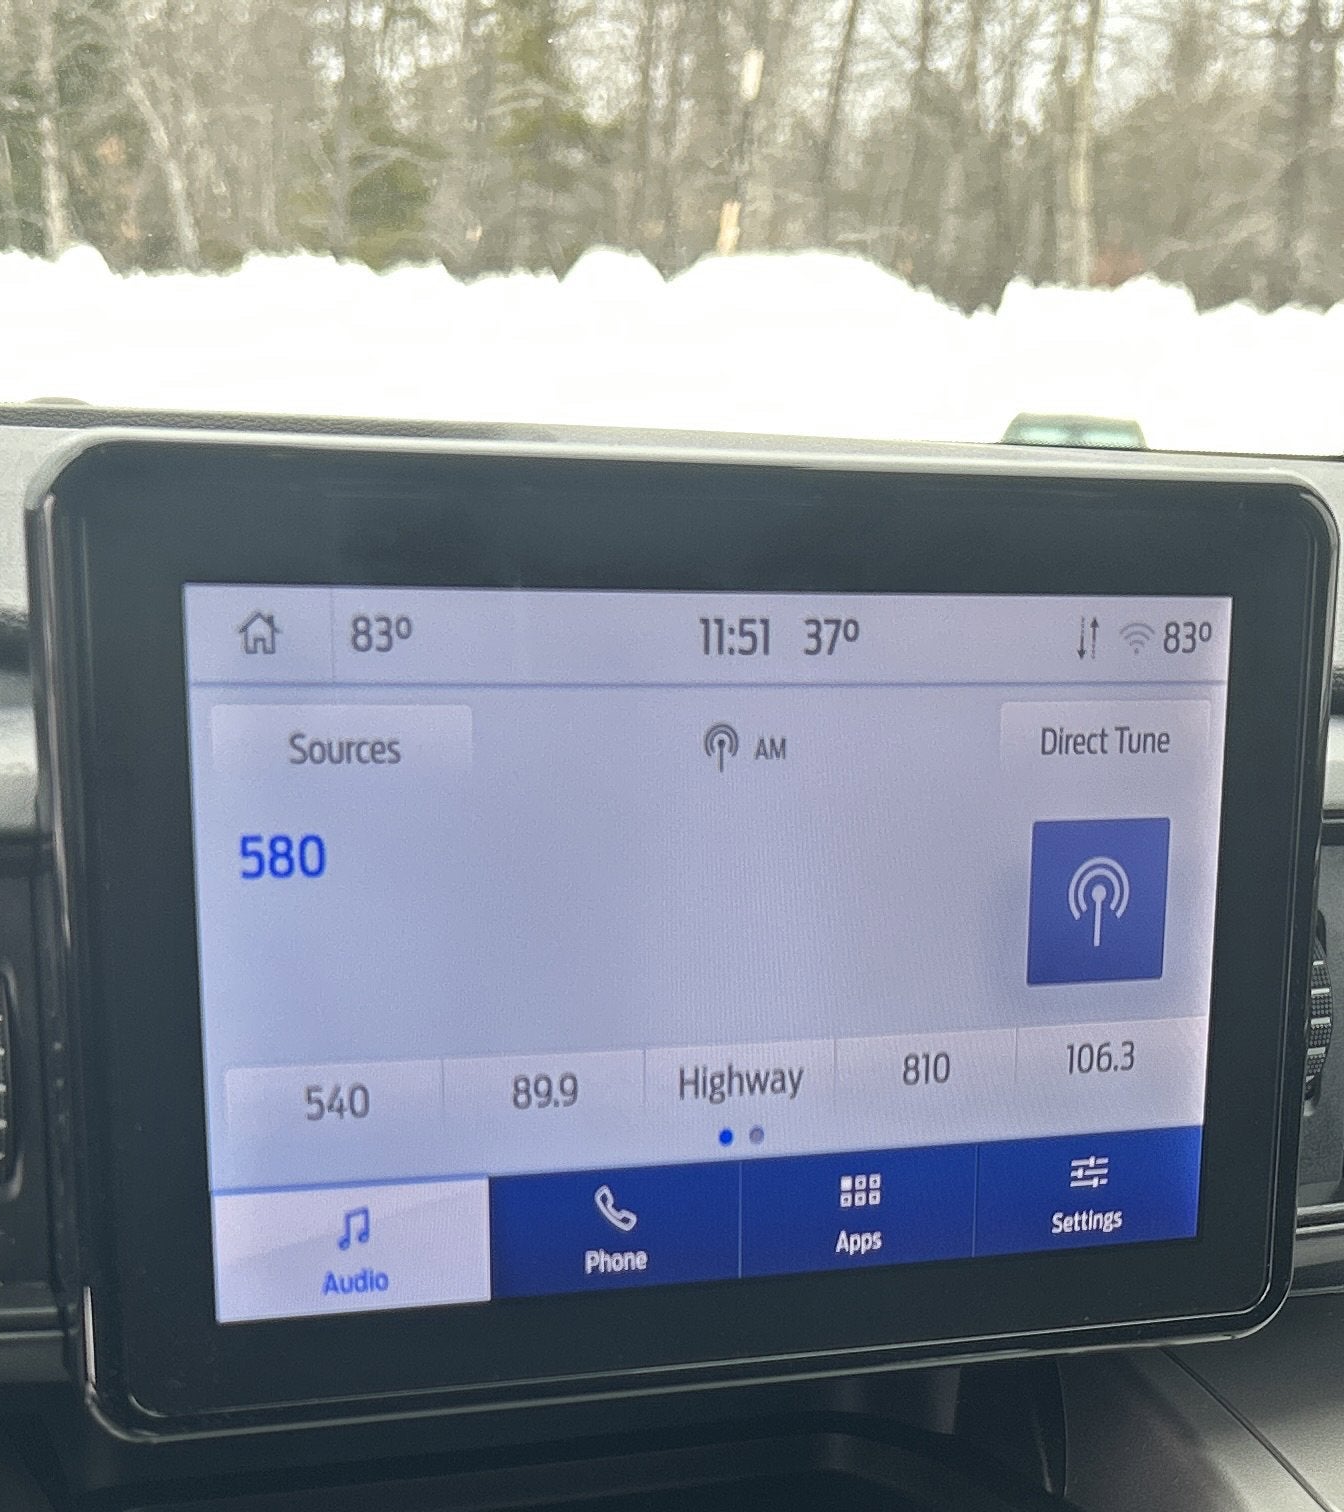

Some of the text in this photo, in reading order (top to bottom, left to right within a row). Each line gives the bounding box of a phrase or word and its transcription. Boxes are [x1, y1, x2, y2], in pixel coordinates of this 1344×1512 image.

[699, 616, 771, 655] 11:51
[288, 732, 402, 766] Sources
[754, 737, 788, 761] AM
[1040, 726, 1171, 757] Direct Tune
[239, 834, 327, 880] 580
[902, 1051, 951, 1087] 810
[1065, 1040, 1136, 1076] 106.3
[512, 1071, 579, 1110] 89.9
[678, 1063, 805, 1104] Highway
[305, 1082, 371, 1121] 540
[1051, 1208, 1123, 1235] Settings
[835, 1229, 883, 1256] Apps
[584, 1248, 649, 1275] Phone
[321, 1268, 390, 1297] Audio
